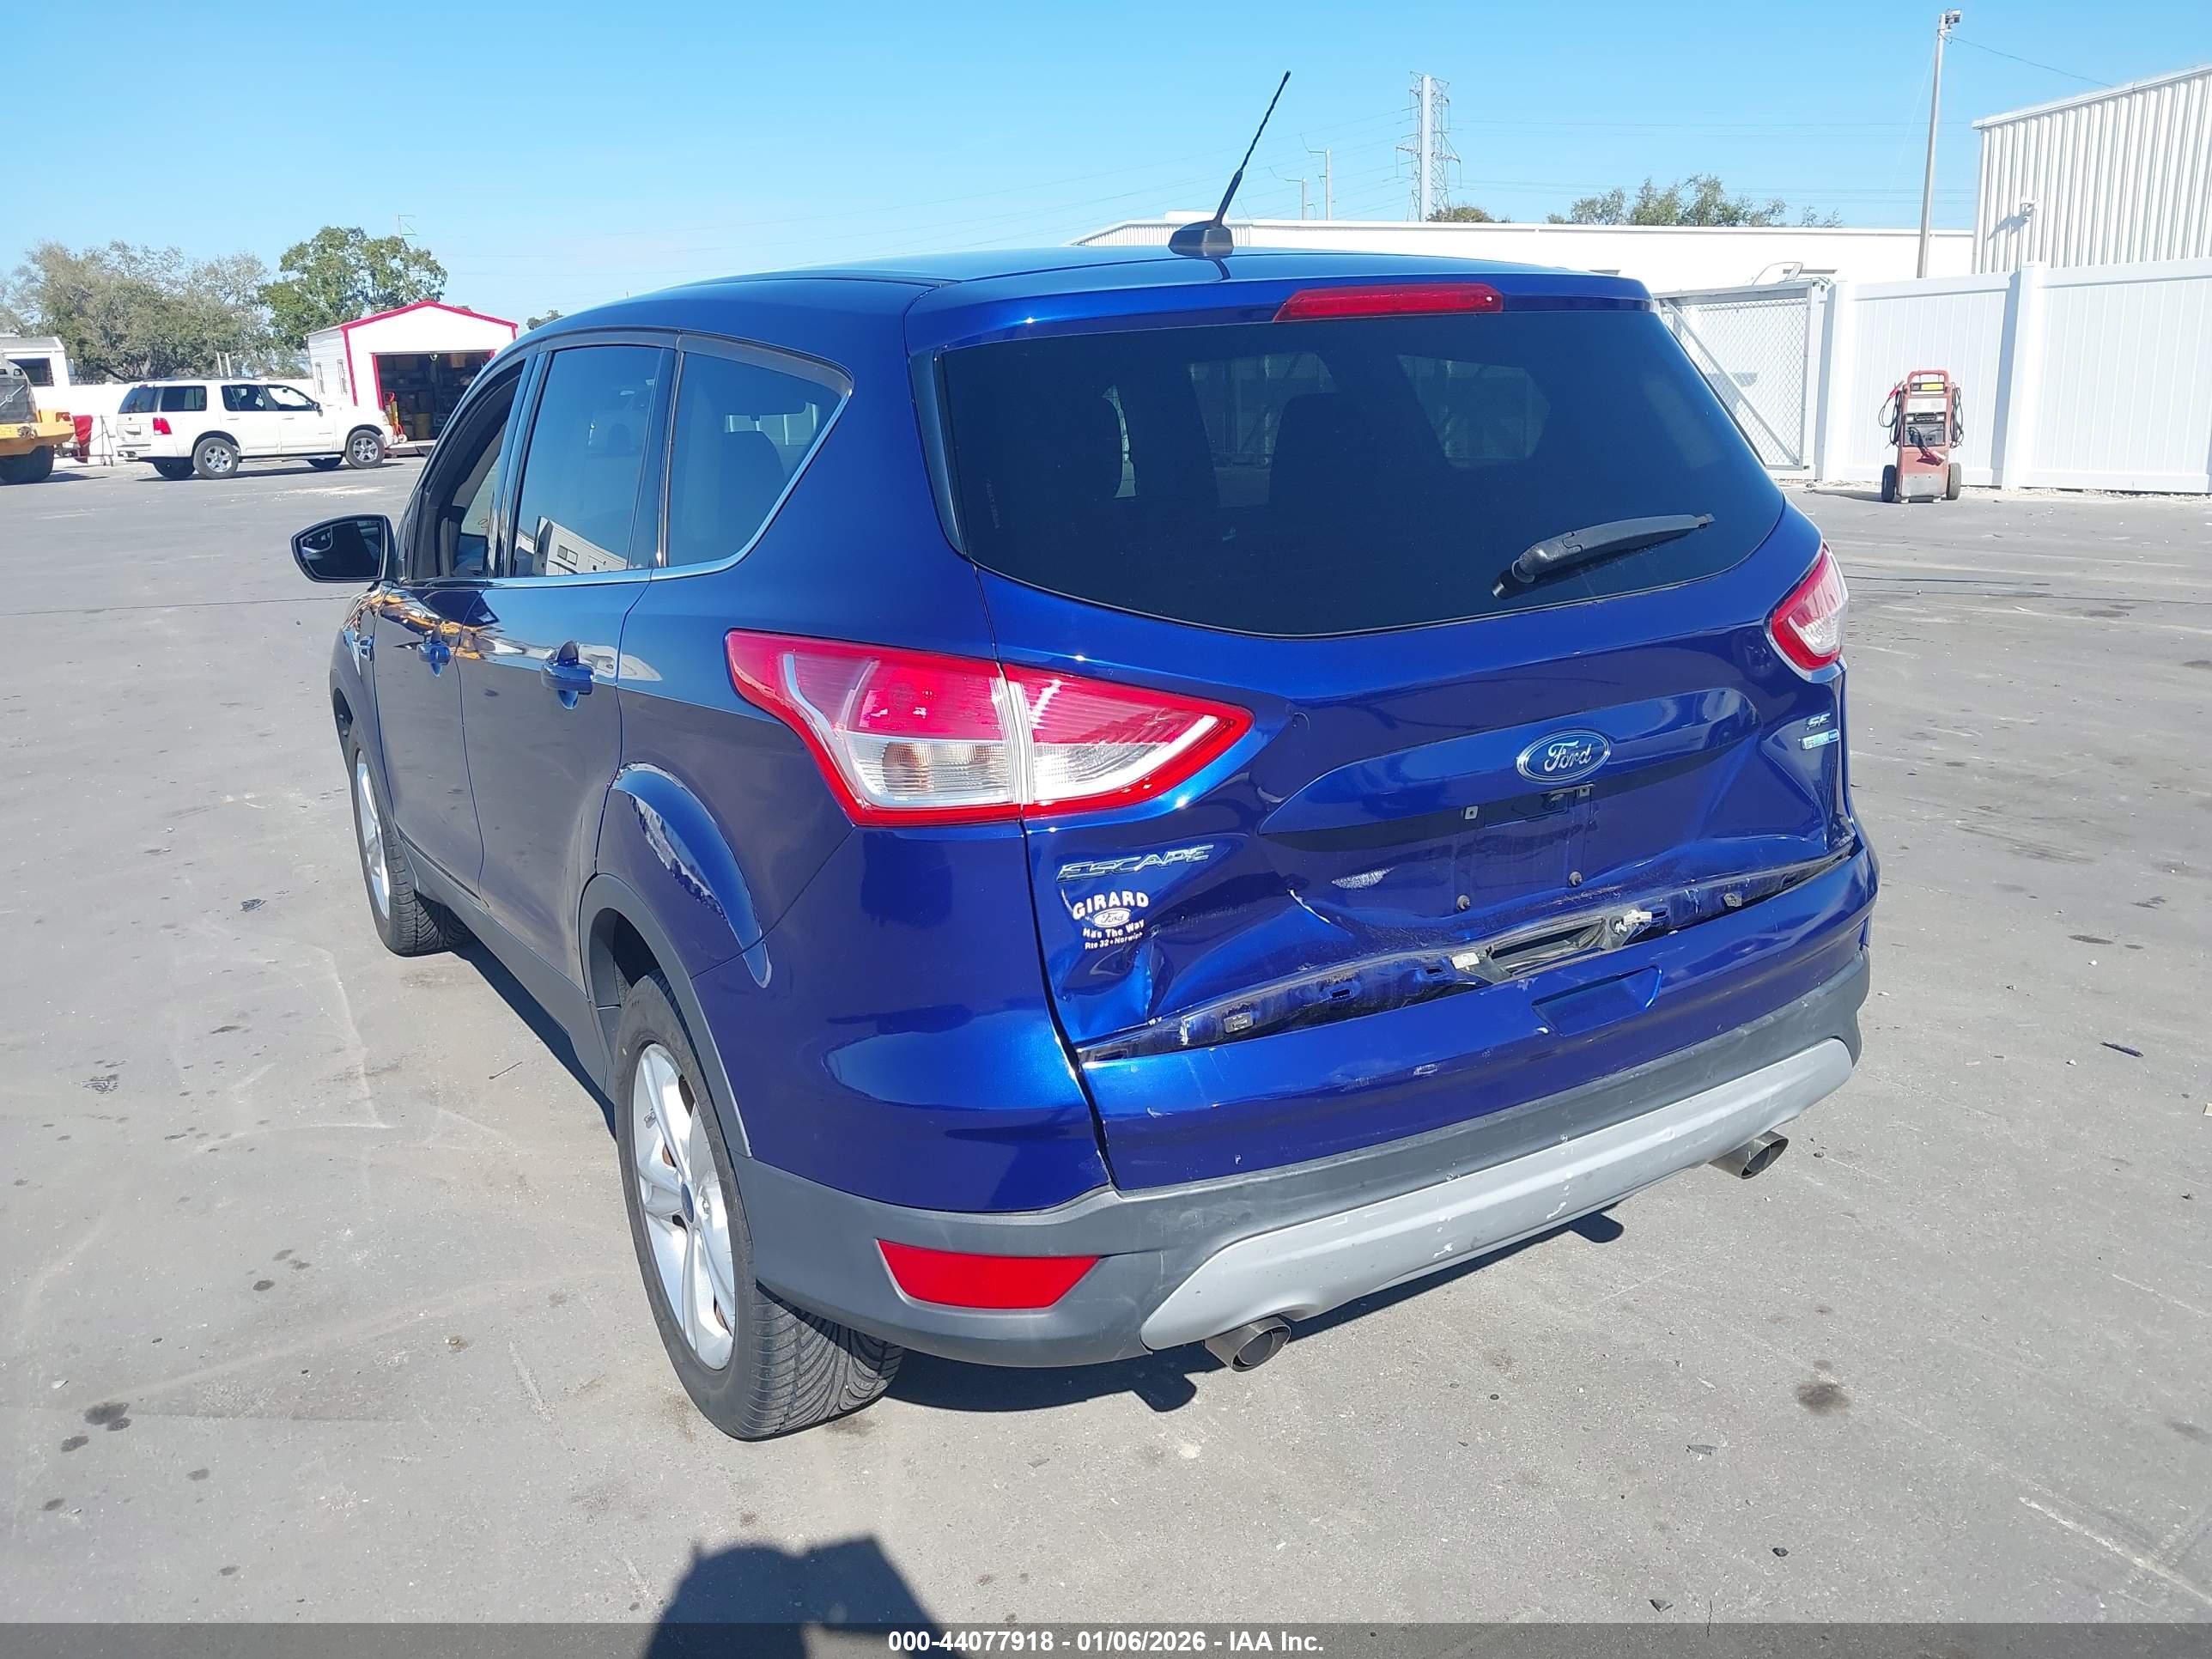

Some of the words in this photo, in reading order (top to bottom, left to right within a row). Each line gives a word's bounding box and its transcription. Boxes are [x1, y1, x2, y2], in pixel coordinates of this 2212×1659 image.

[1544, 740, 1593, 772] Ford
[1056, 844, 1214, 883] ESCAPE
[1073, 890, 1150, 920] GIRARD
[1083, 927, 1103, 939] Has
[1105, 927, 1123, 939] The
[1125, 919, 1145, 933] Way
